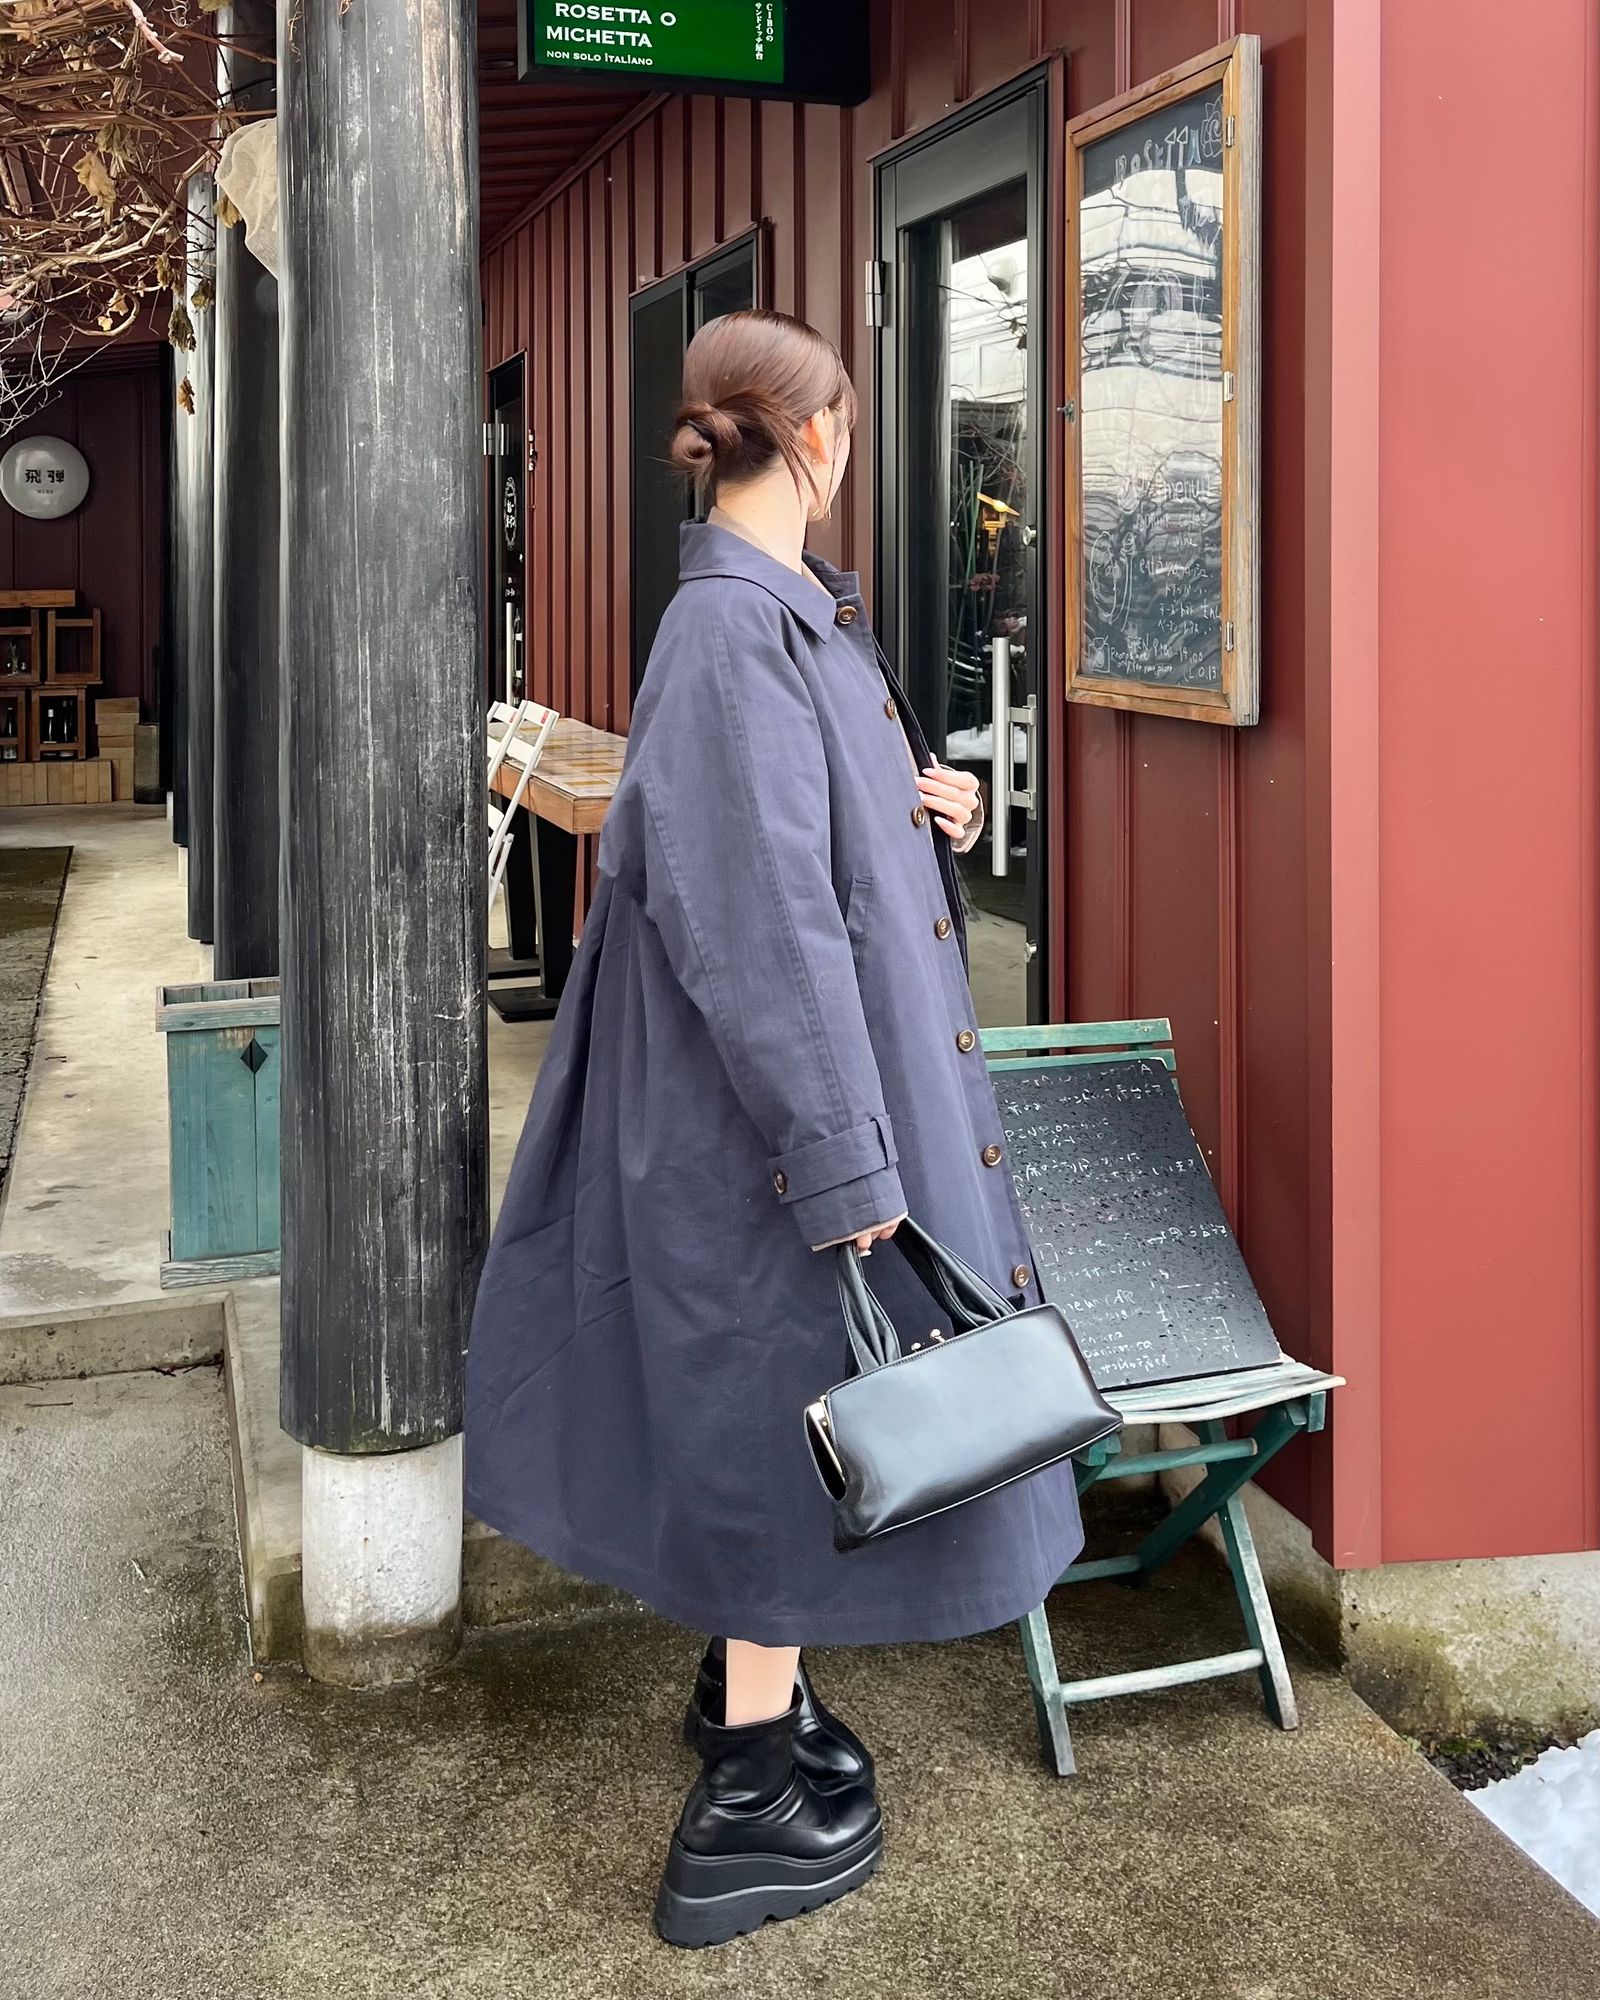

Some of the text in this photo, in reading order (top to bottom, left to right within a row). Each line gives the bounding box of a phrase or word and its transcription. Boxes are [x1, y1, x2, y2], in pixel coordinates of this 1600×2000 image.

[555, 2, 677, 26] ROSETTA O
[546, 25, 653, 48] MICHETTA
[546, 50, 570, 60] NON
[573, 52, 602, 62] SOLO
